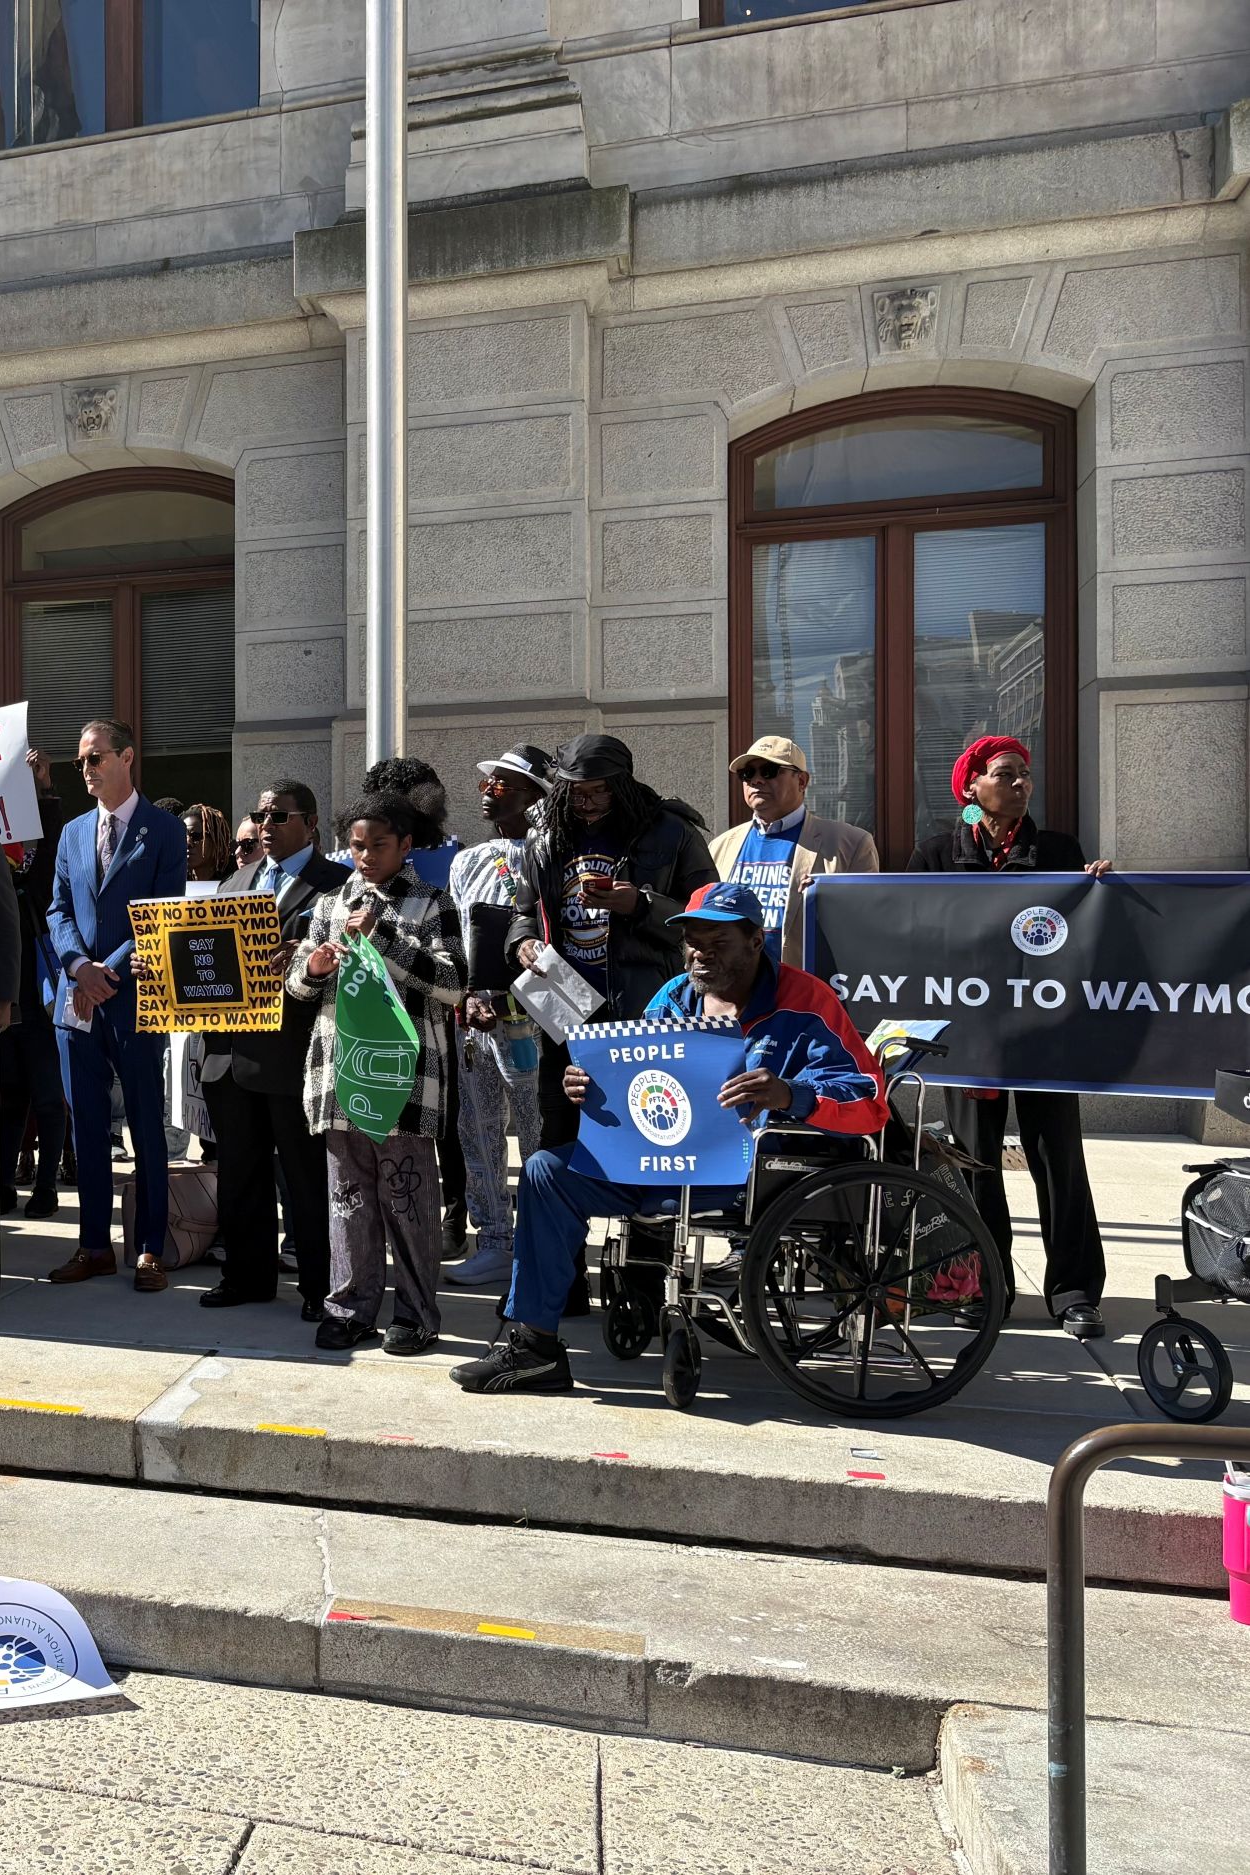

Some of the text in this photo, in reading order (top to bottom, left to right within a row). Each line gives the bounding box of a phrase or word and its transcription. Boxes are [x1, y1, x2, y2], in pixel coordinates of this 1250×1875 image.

[131, 909, 159, 921] SAY
[163, 908, 182, 920] NO
[185, 907, 207, 919] TO
[210, 901, 277, 917] WAYMO
[1013, 909, 1066, 930] PEOPLE FIRST
[134, 923, 161, 936] SAY
[137, 939, 161, 951] SAY
[189, 938, 215, 951] SAY
[194, 954, 214, 966] NO
[197, 970, 216, 982] TO
[138, 985, 167, 996] SAY
[183, 984, 234, 997] WAYMO
[829, 973, 908, 1003] SAY
[924, 976, 990, 1007] NO
[1006, 977, 1067, 1009] TO
[139, 1000, 168, 1011] SAY
[138, 1012, 281, 1027] SAY NO TO WAYMO
[609, 1043, 685, 1063] PEOPLE
[631, 1073, 686, 1106] PEOPLE FIRST
[649, 1095, 667, 1104] PFTA
[640, 1155, 697, 1172] FIRST
